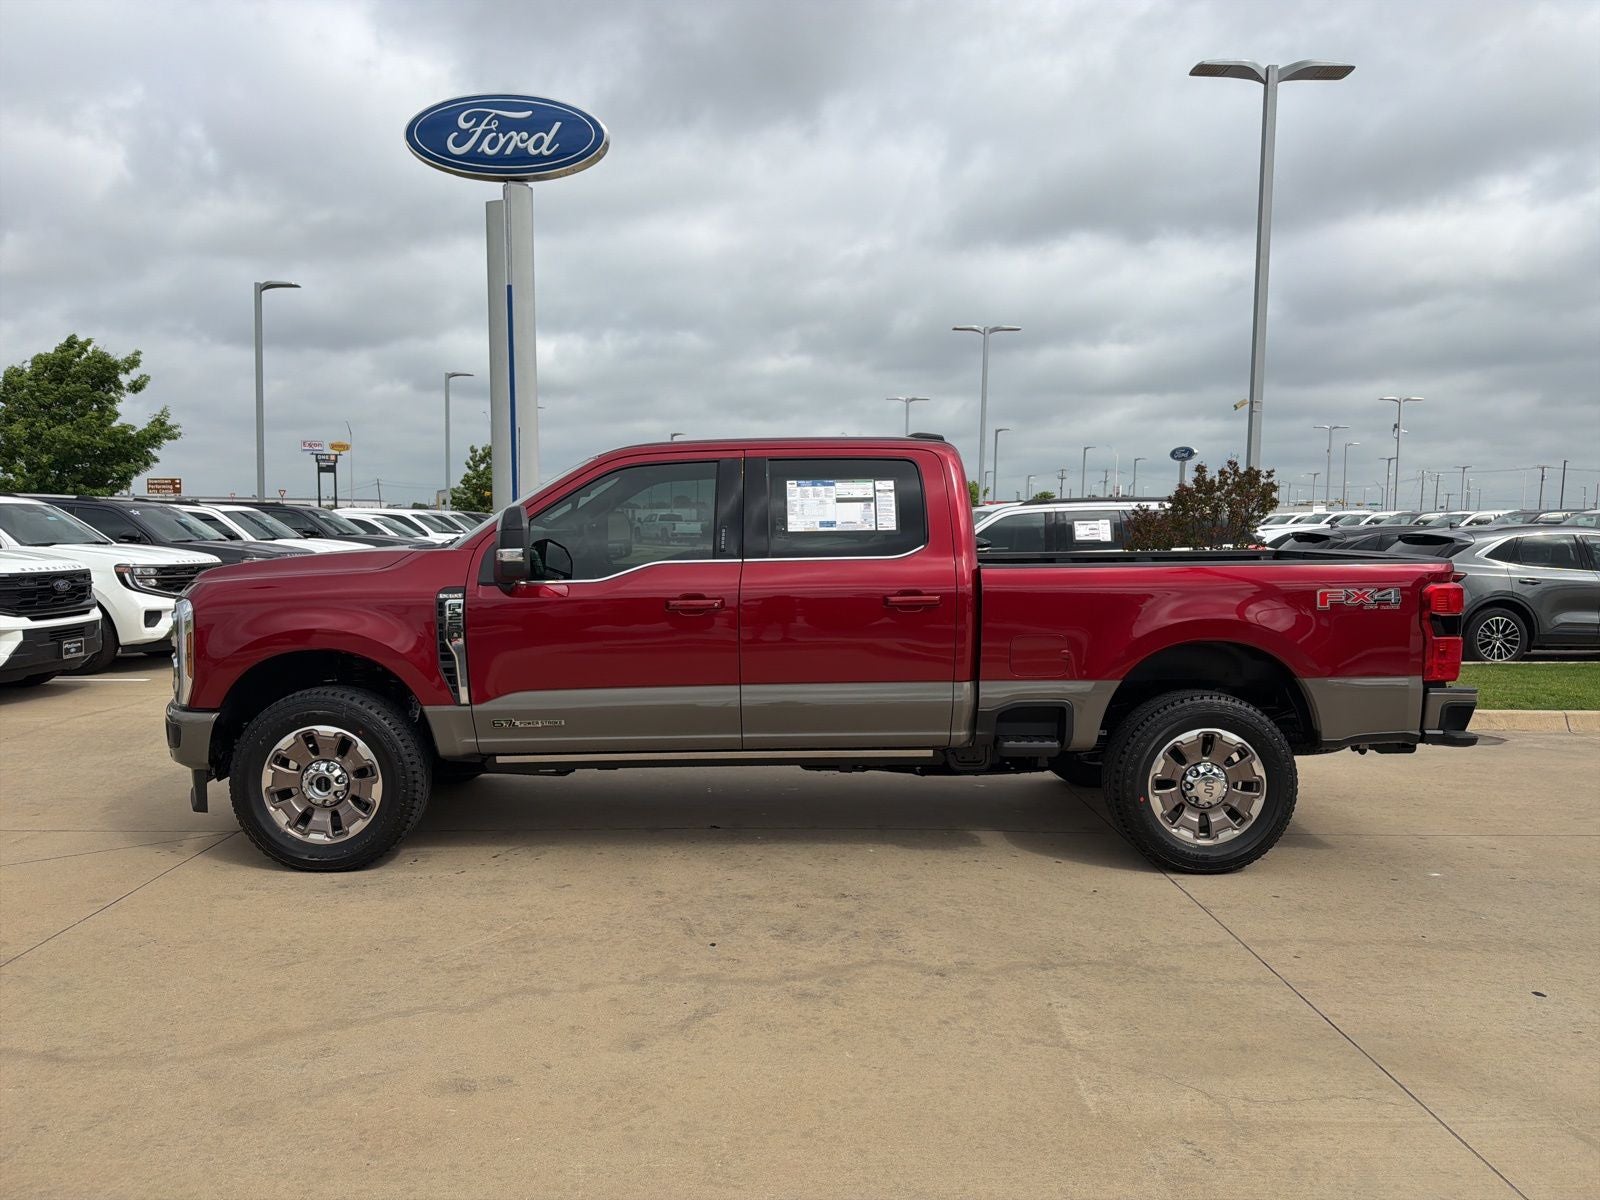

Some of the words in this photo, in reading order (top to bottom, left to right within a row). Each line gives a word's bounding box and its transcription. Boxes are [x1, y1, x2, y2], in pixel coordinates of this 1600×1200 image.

[447, 108, 562, 156] Ford
[303, 441, 323, 449] Exxon
[1317, 588, 1401, 610] FX4
